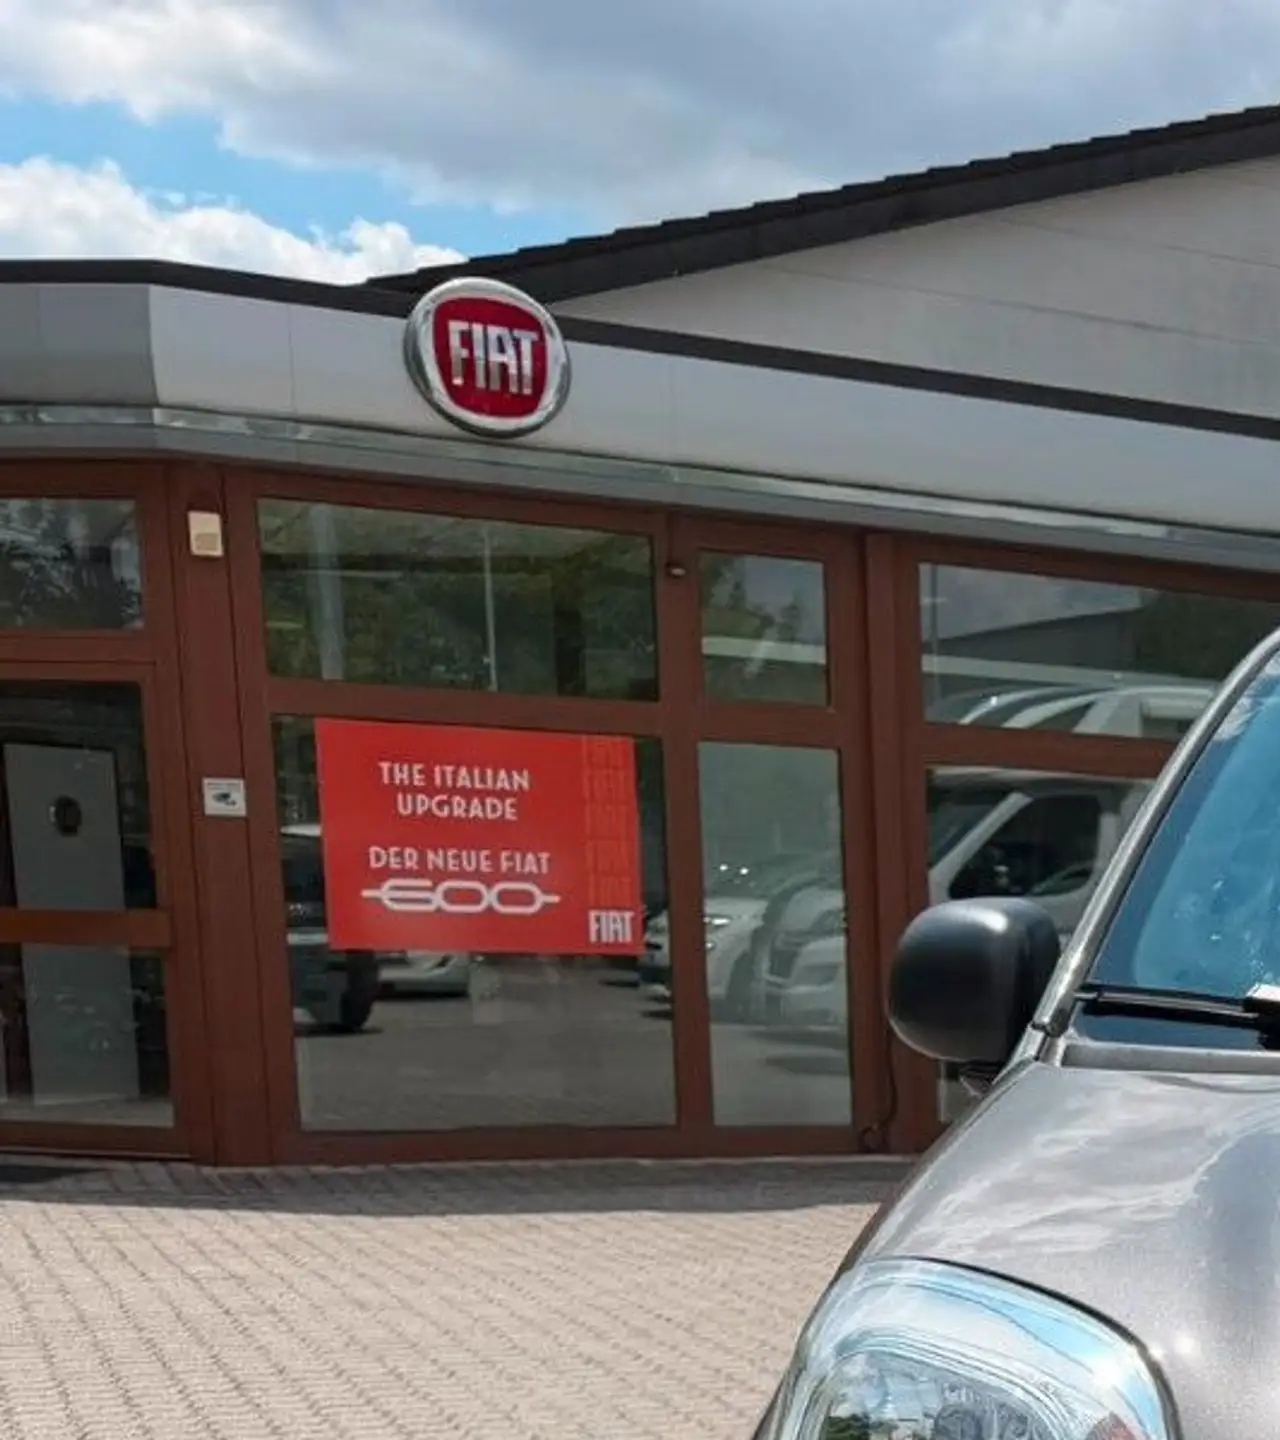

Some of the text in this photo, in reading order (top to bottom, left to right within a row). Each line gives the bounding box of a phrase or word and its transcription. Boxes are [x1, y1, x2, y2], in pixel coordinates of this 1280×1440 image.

[448, 319, 539, 395] FIAT
[379, 761, 530, 791] THE ITALIAN
[397, 792, 518, 821] UPGRADE
[369, 845, 550, 875] DER NEUE FIAT
[361, 878, 561, 915] 600
[588, 909, 634, 944] FIAT
